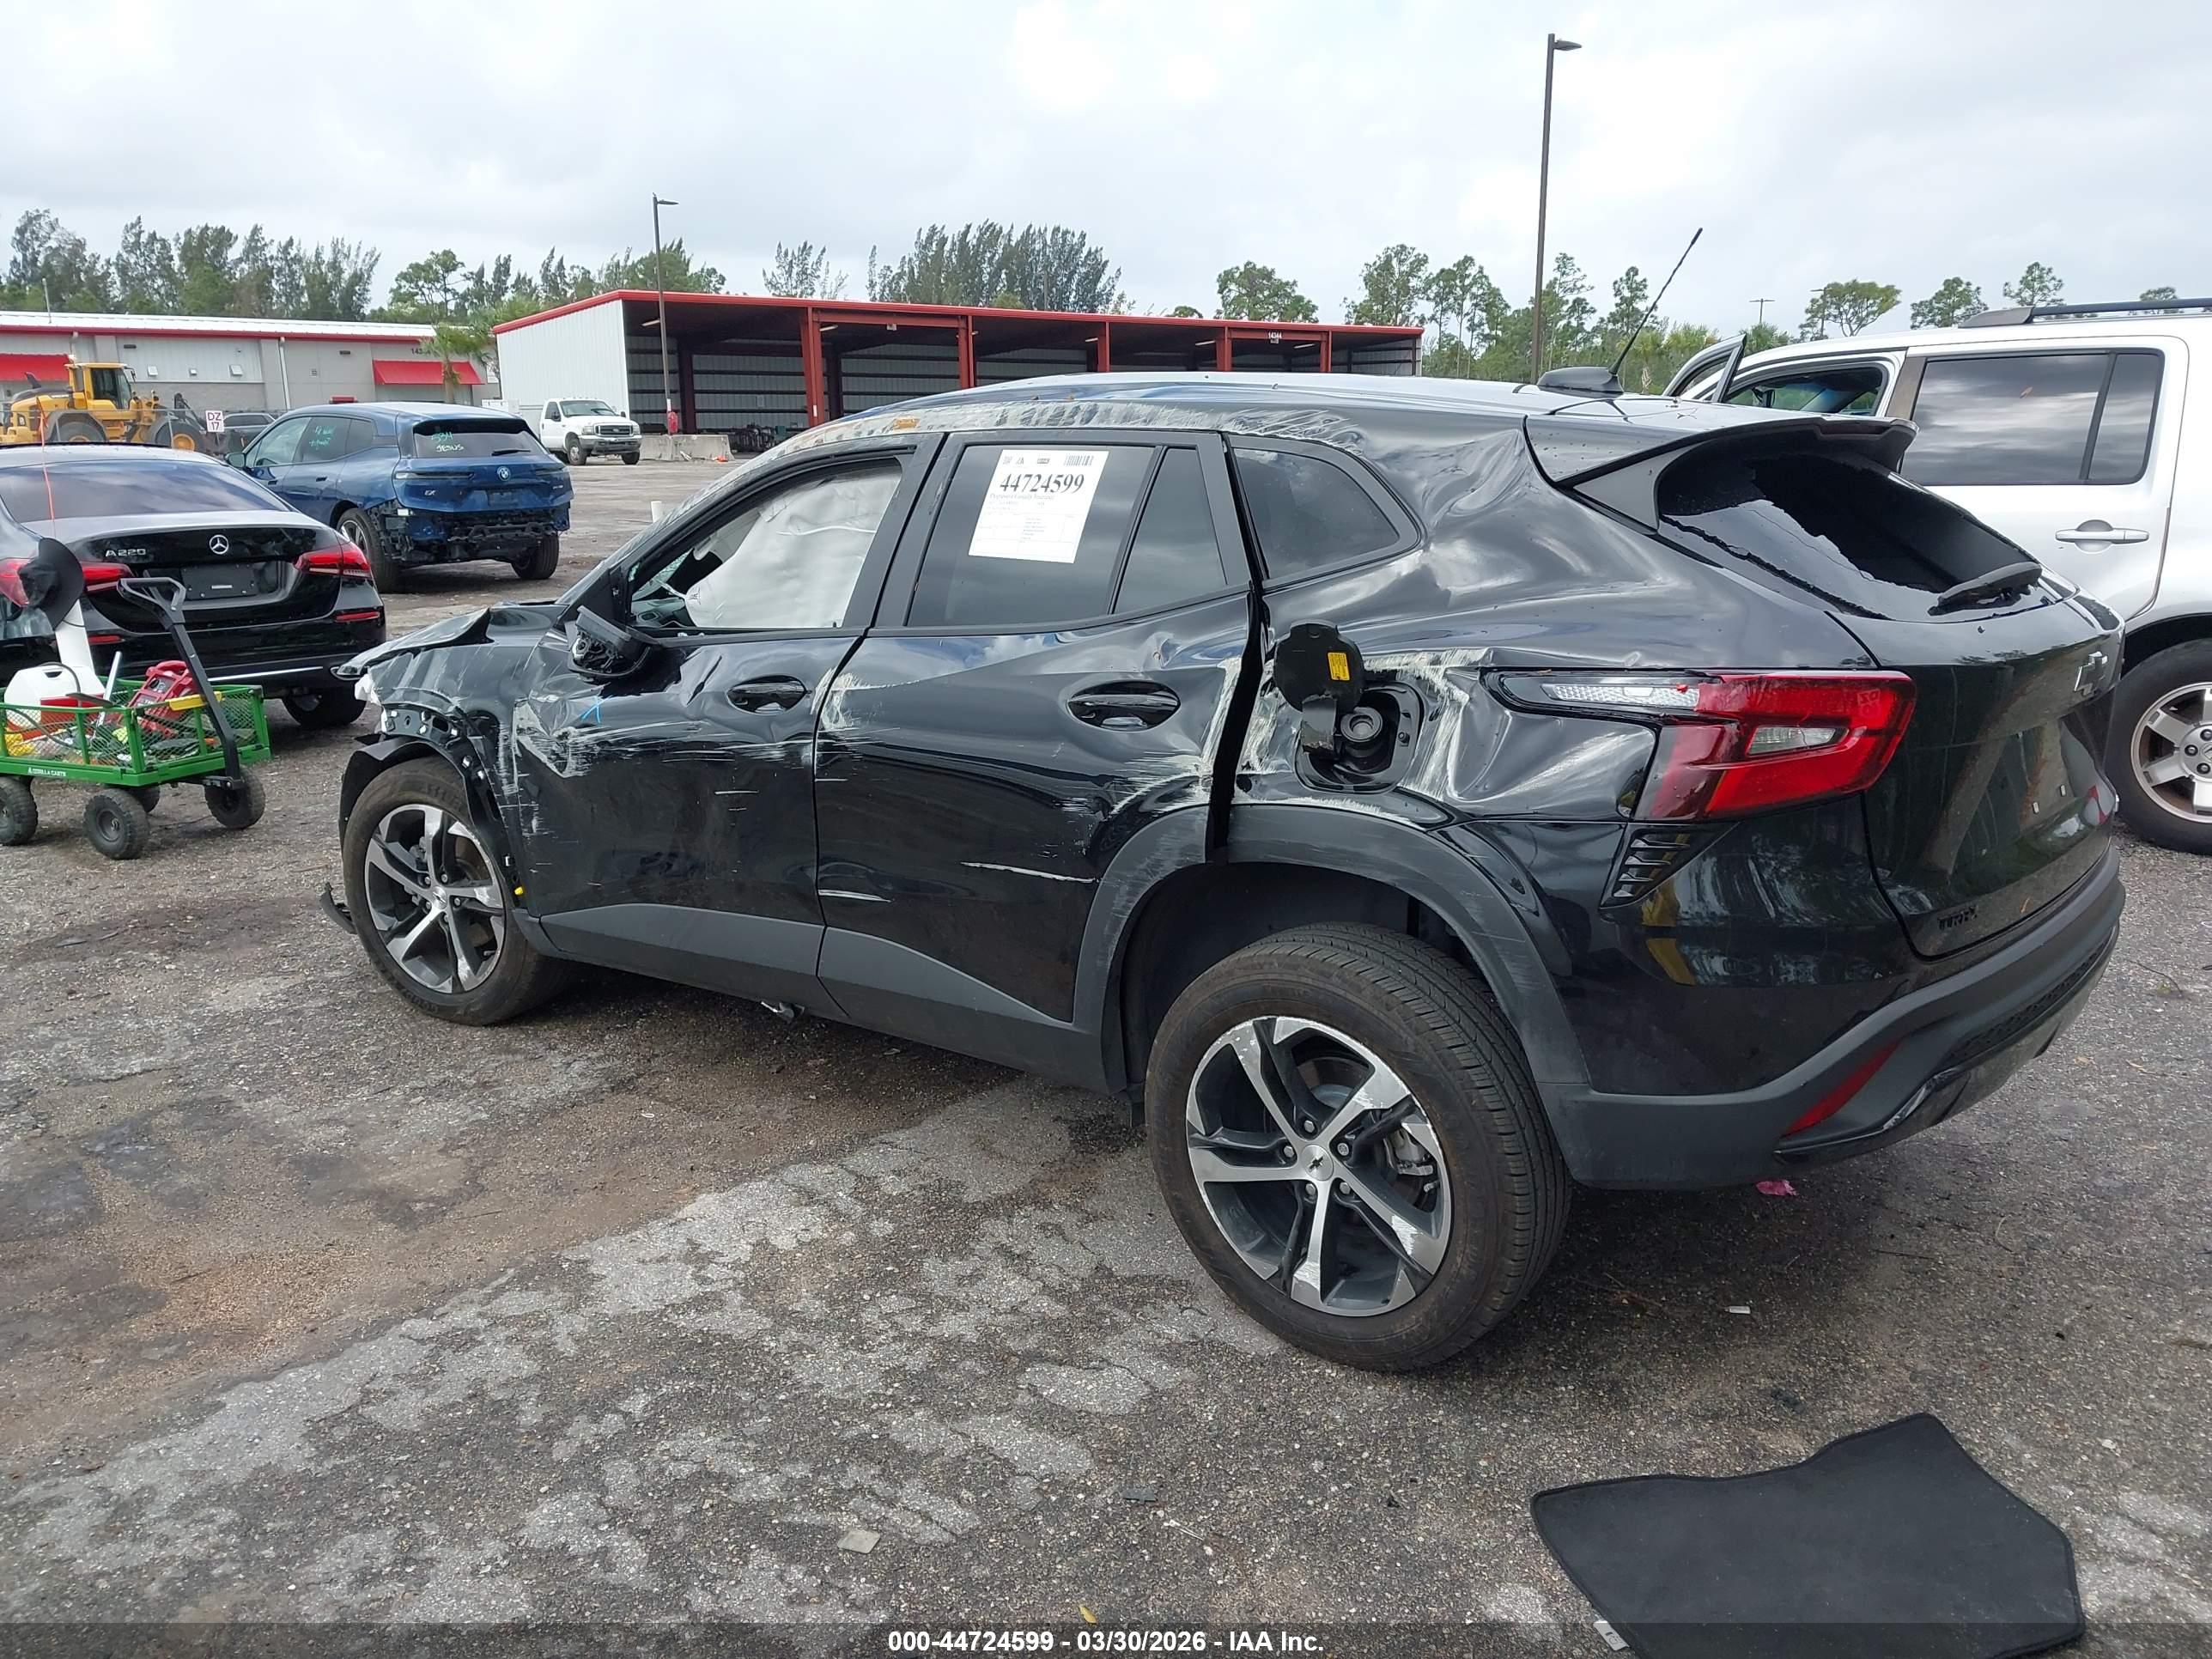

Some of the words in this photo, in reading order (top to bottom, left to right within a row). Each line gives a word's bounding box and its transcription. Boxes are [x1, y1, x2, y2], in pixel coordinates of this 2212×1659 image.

[207, 412, 222, 421] DZ
[211, 422, 219, 430] 17
[435, 444, 465, 453] JESUS
[999, 473, 1085, 494] 44724599
